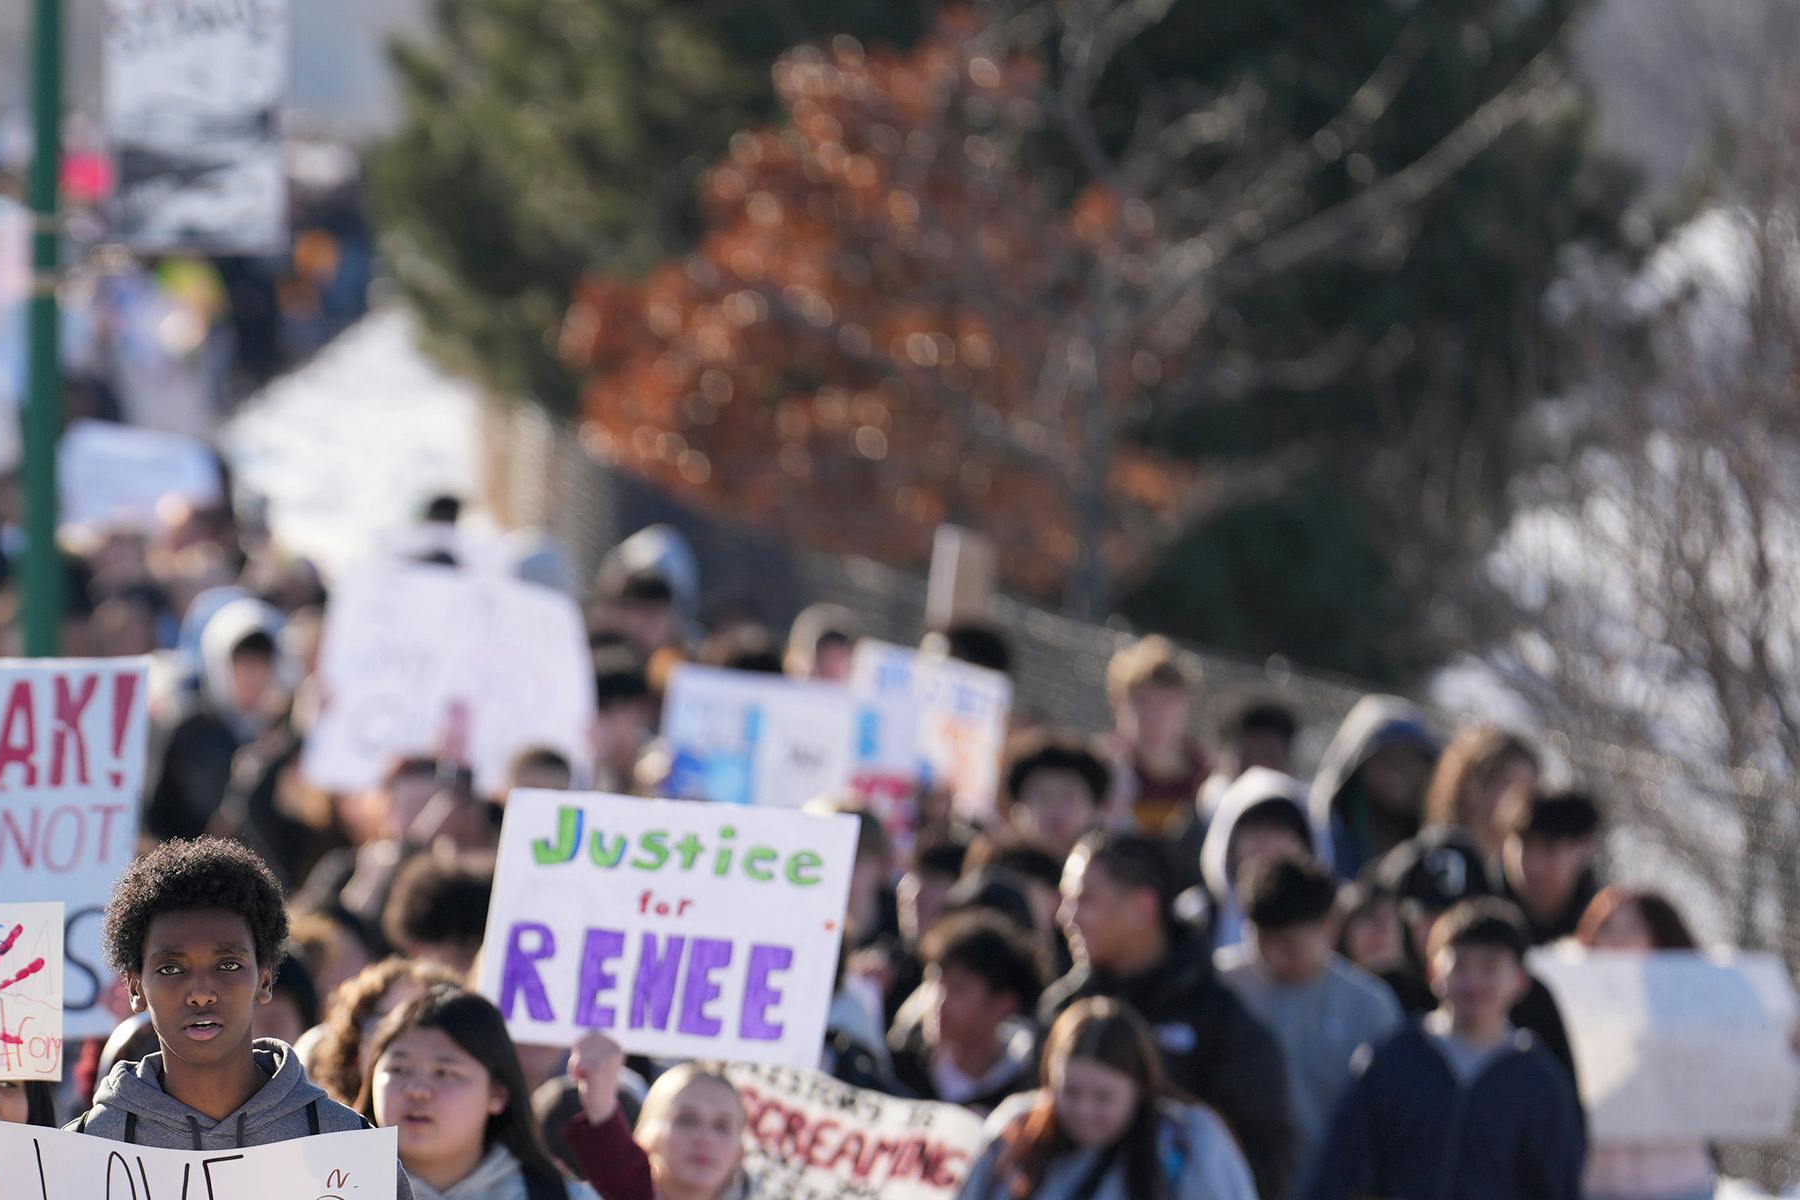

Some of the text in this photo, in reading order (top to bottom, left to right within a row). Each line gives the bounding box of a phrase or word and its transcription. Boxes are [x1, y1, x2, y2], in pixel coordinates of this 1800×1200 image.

[532, 804, 825, 887] Justice
[638, 889, 695, 917] for
[500, 921, 795, 1042] RENEE
